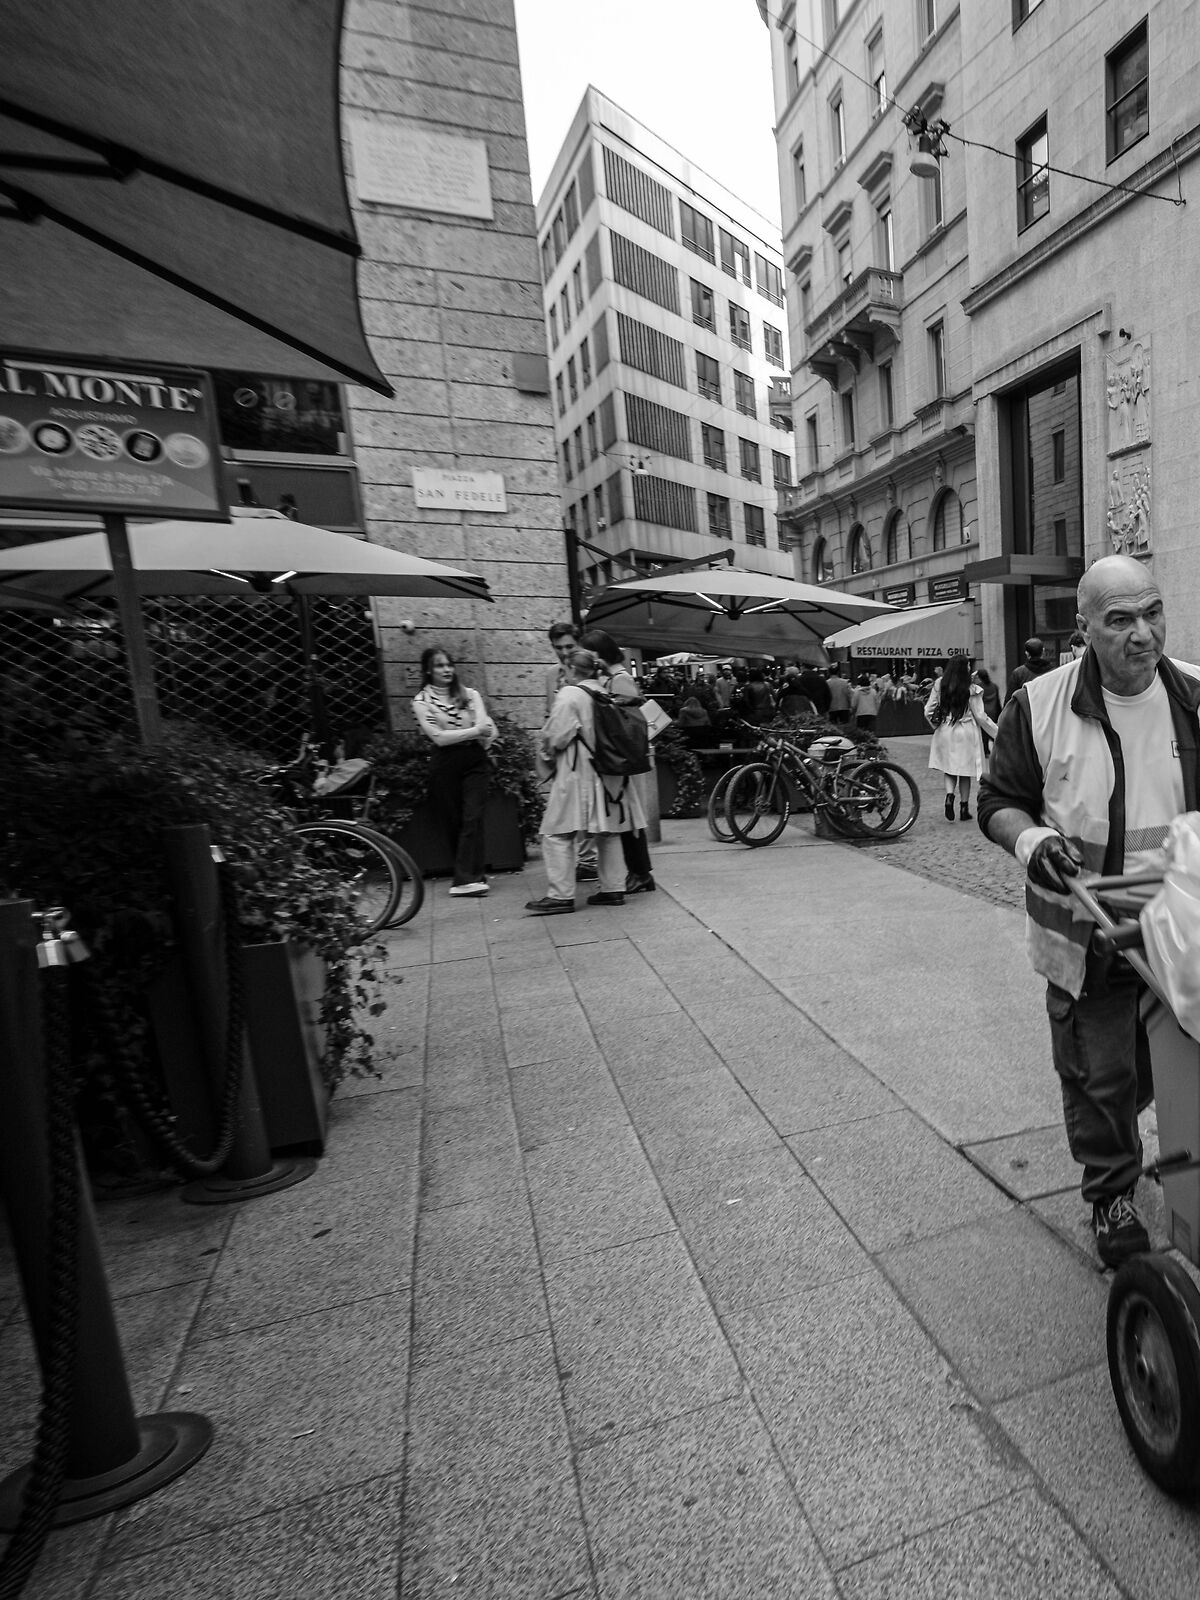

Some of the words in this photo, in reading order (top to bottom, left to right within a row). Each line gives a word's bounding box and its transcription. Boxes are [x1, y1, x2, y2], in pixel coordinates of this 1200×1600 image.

[43, 372, 196, 413] MONTE
[417, 488, 444, 498] SAN
[455, 490, 502, 503] FEDELE
[857, 646, 913, 657] RESTAURANT
[917, 647, 943, 657] PIZZA
[947, 648, 971, 657] GRILL
